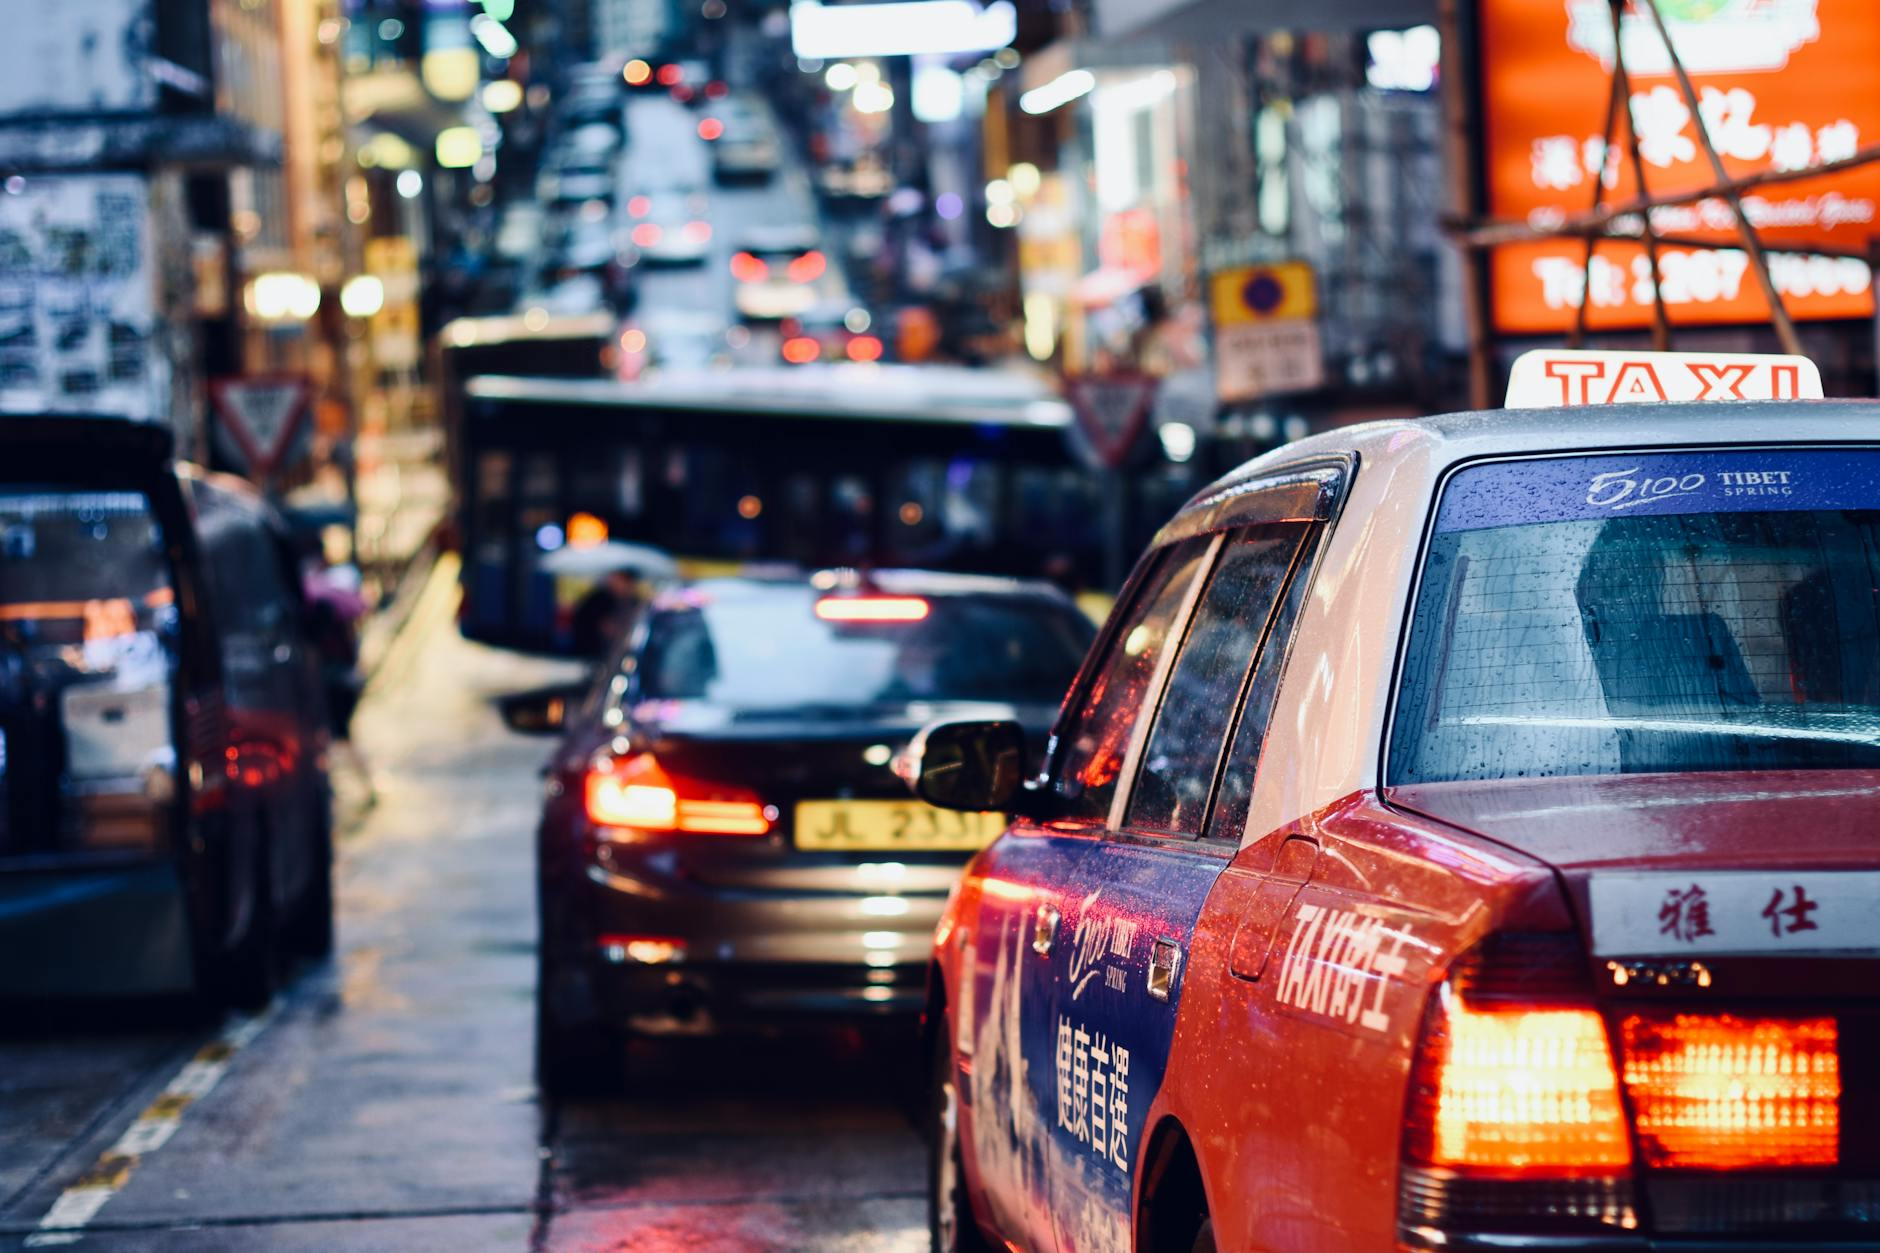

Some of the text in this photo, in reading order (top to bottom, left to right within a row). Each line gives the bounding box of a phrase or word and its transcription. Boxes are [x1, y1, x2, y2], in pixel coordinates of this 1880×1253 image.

[1545, 360, 1799, 406] TAXI
[1586, 467, 1706, 510] 5100
[1717, 471, 1791, 486] TIBET
[1724, 487, 1793, 496] SPRING
[815, 811, 865, 841] JL
[1658, 883, 1818, 943] 雅仕
[1104, 965, 1128, 993] SPRING
[1056, 1013, 1130, 1174] 健康首選
